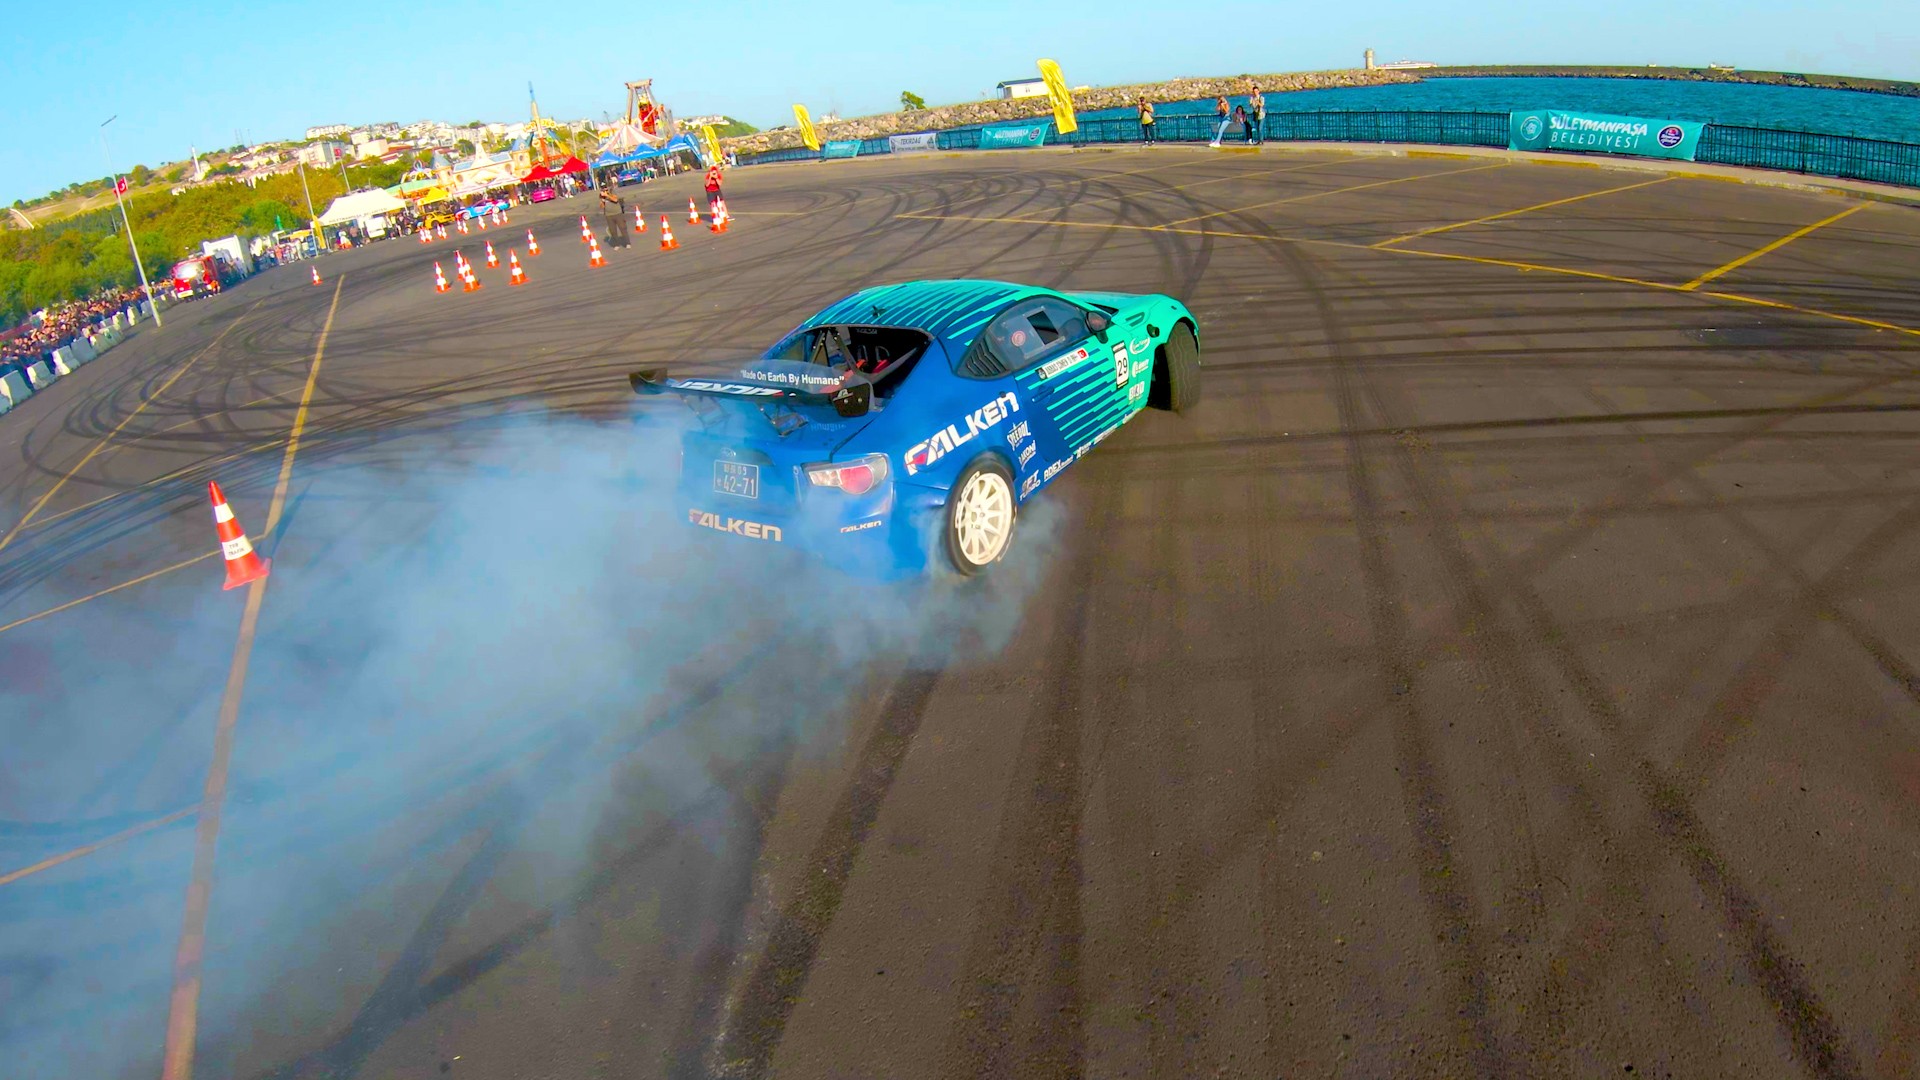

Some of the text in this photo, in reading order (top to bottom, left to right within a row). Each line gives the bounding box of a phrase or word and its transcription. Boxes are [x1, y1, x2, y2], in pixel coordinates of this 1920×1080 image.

[1549, 114, 1648, 137] SÜLEYMANPAŞA
[1551, 131, 1639, 149] BELEDİYESİ
[1118, 357, 1128, 377] 29
[757, 371, 767, 381] On
[768, 372, 787, 382] Earth
[788, 373, 800, 385] By
[904, 391, 1020, 476] FALKEN
[723, 475, 756, 497] 42-71
[689, 509, 782, 541] FALKEN
[840, 520, 881, 534] FALKEN
